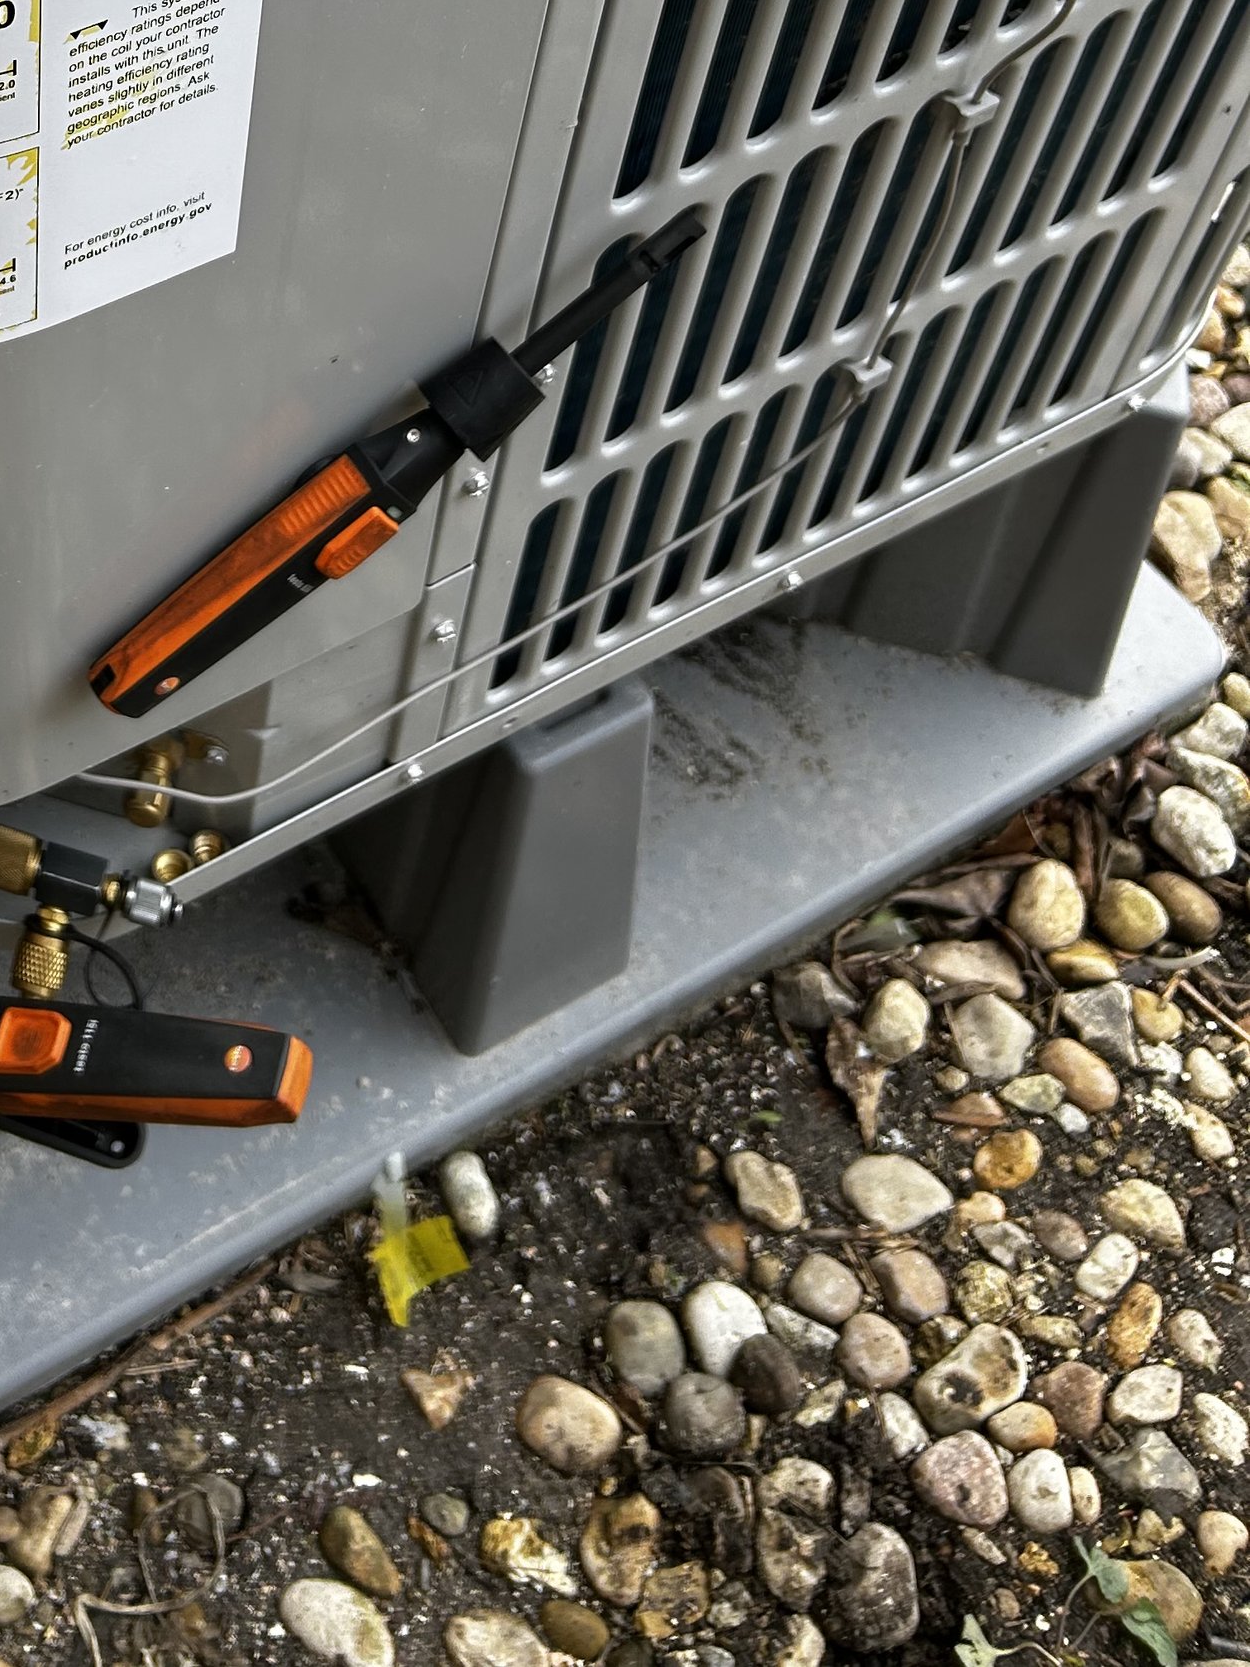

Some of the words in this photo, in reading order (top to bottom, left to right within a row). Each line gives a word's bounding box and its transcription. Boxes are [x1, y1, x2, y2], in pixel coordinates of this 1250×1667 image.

[68, 30, 128, 58] efficiency
[131, 12, 172, 36] ratings
[68, 61, 85, 74] on
[88, 50, 108, 66] the
[110, 41, 133, 58] coil
[135, 32, 163, 51] your
[165, 7, 226, 37] contractor
[131, 3, 158, 19] This
[67, 65, 111, 89] installs
[114, 54, 140, 72] with
[142, 46, 165, 61] this
[196, 25, 220, 41] The
[67, 97, 104, 118] varies
[107, 79, 150, 103] slightly
[152, 73, 164, 87] in
[166, 55, 215, 81] different
[68, 80, 114, 103] heating
[116, 58, 173, 85] efficiency
[176, 42, 210, 63] rating
[67, 101, 135, 135] geographic
[187, 70, 211, 87] Ask
[67, 130, 94, 150] your
[97, 106, 158, 136] contractor
[159, 99, 176, 113] for
[178, 83, 219, 105] details.
[63, 202, 213, 271] productinfo.energy.gov
[64, 241, 85, 256] For
[87, 223, 126, 246] energy
[129, 213, 154, 229] cost
[183, 191, 206, 207] visit
[73, 1042, 91, 1072] testo
